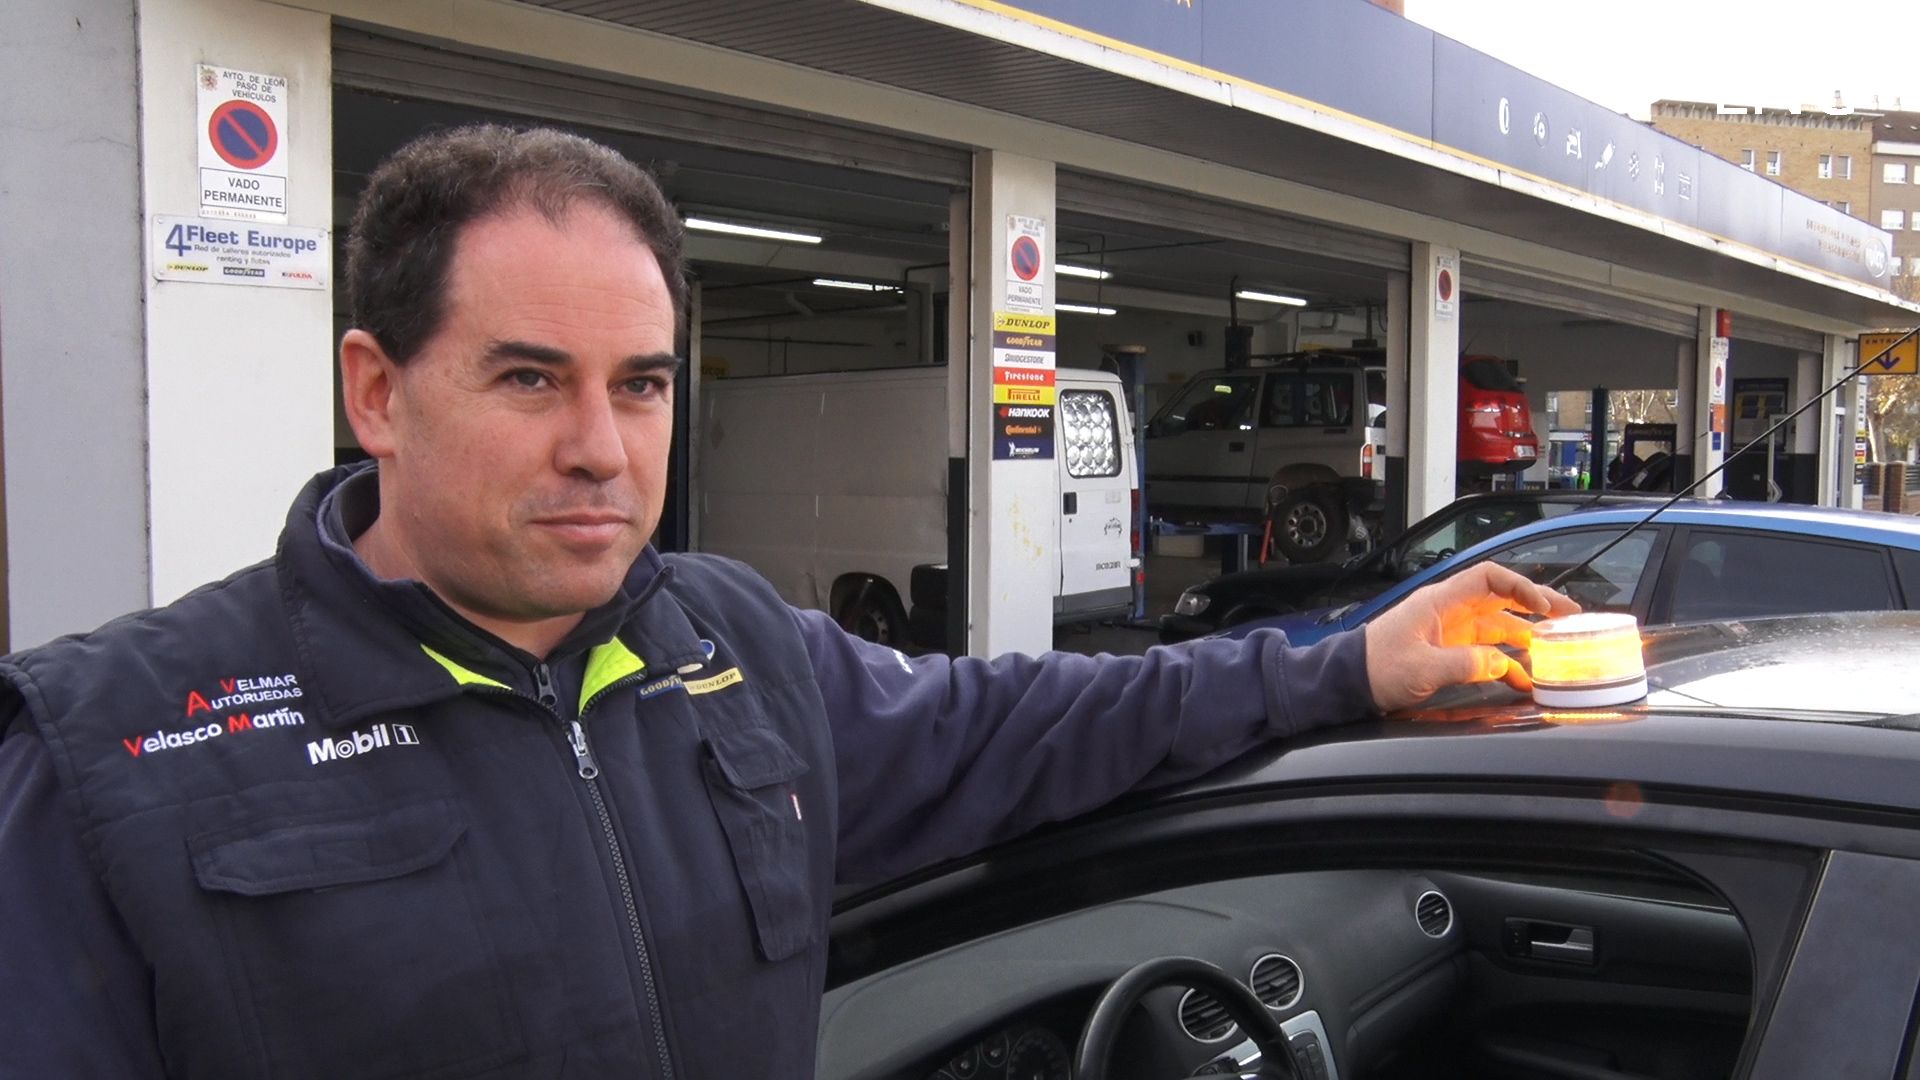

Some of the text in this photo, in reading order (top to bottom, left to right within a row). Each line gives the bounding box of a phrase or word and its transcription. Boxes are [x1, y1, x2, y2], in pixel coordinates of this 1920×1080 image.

[236, 81, 272, 94] PASO DE
[249, 75, 261, 84] DE
[228, 177, 260, 190] VADO
[204, 190, 282, 208] PERMANENTE
[247, 230, 317, 254] Europe
[1006, 318, 1050, 329] DUNLOP
[220, 674, 298, 693] VELMAR
[695, 672, 736, 690] DUNLOP
[186, 686, 302, 718] AUTORUEDAS
[123, 707, 305, 758] Velasco Martín
[307, 723, 390, 765] Mobil
